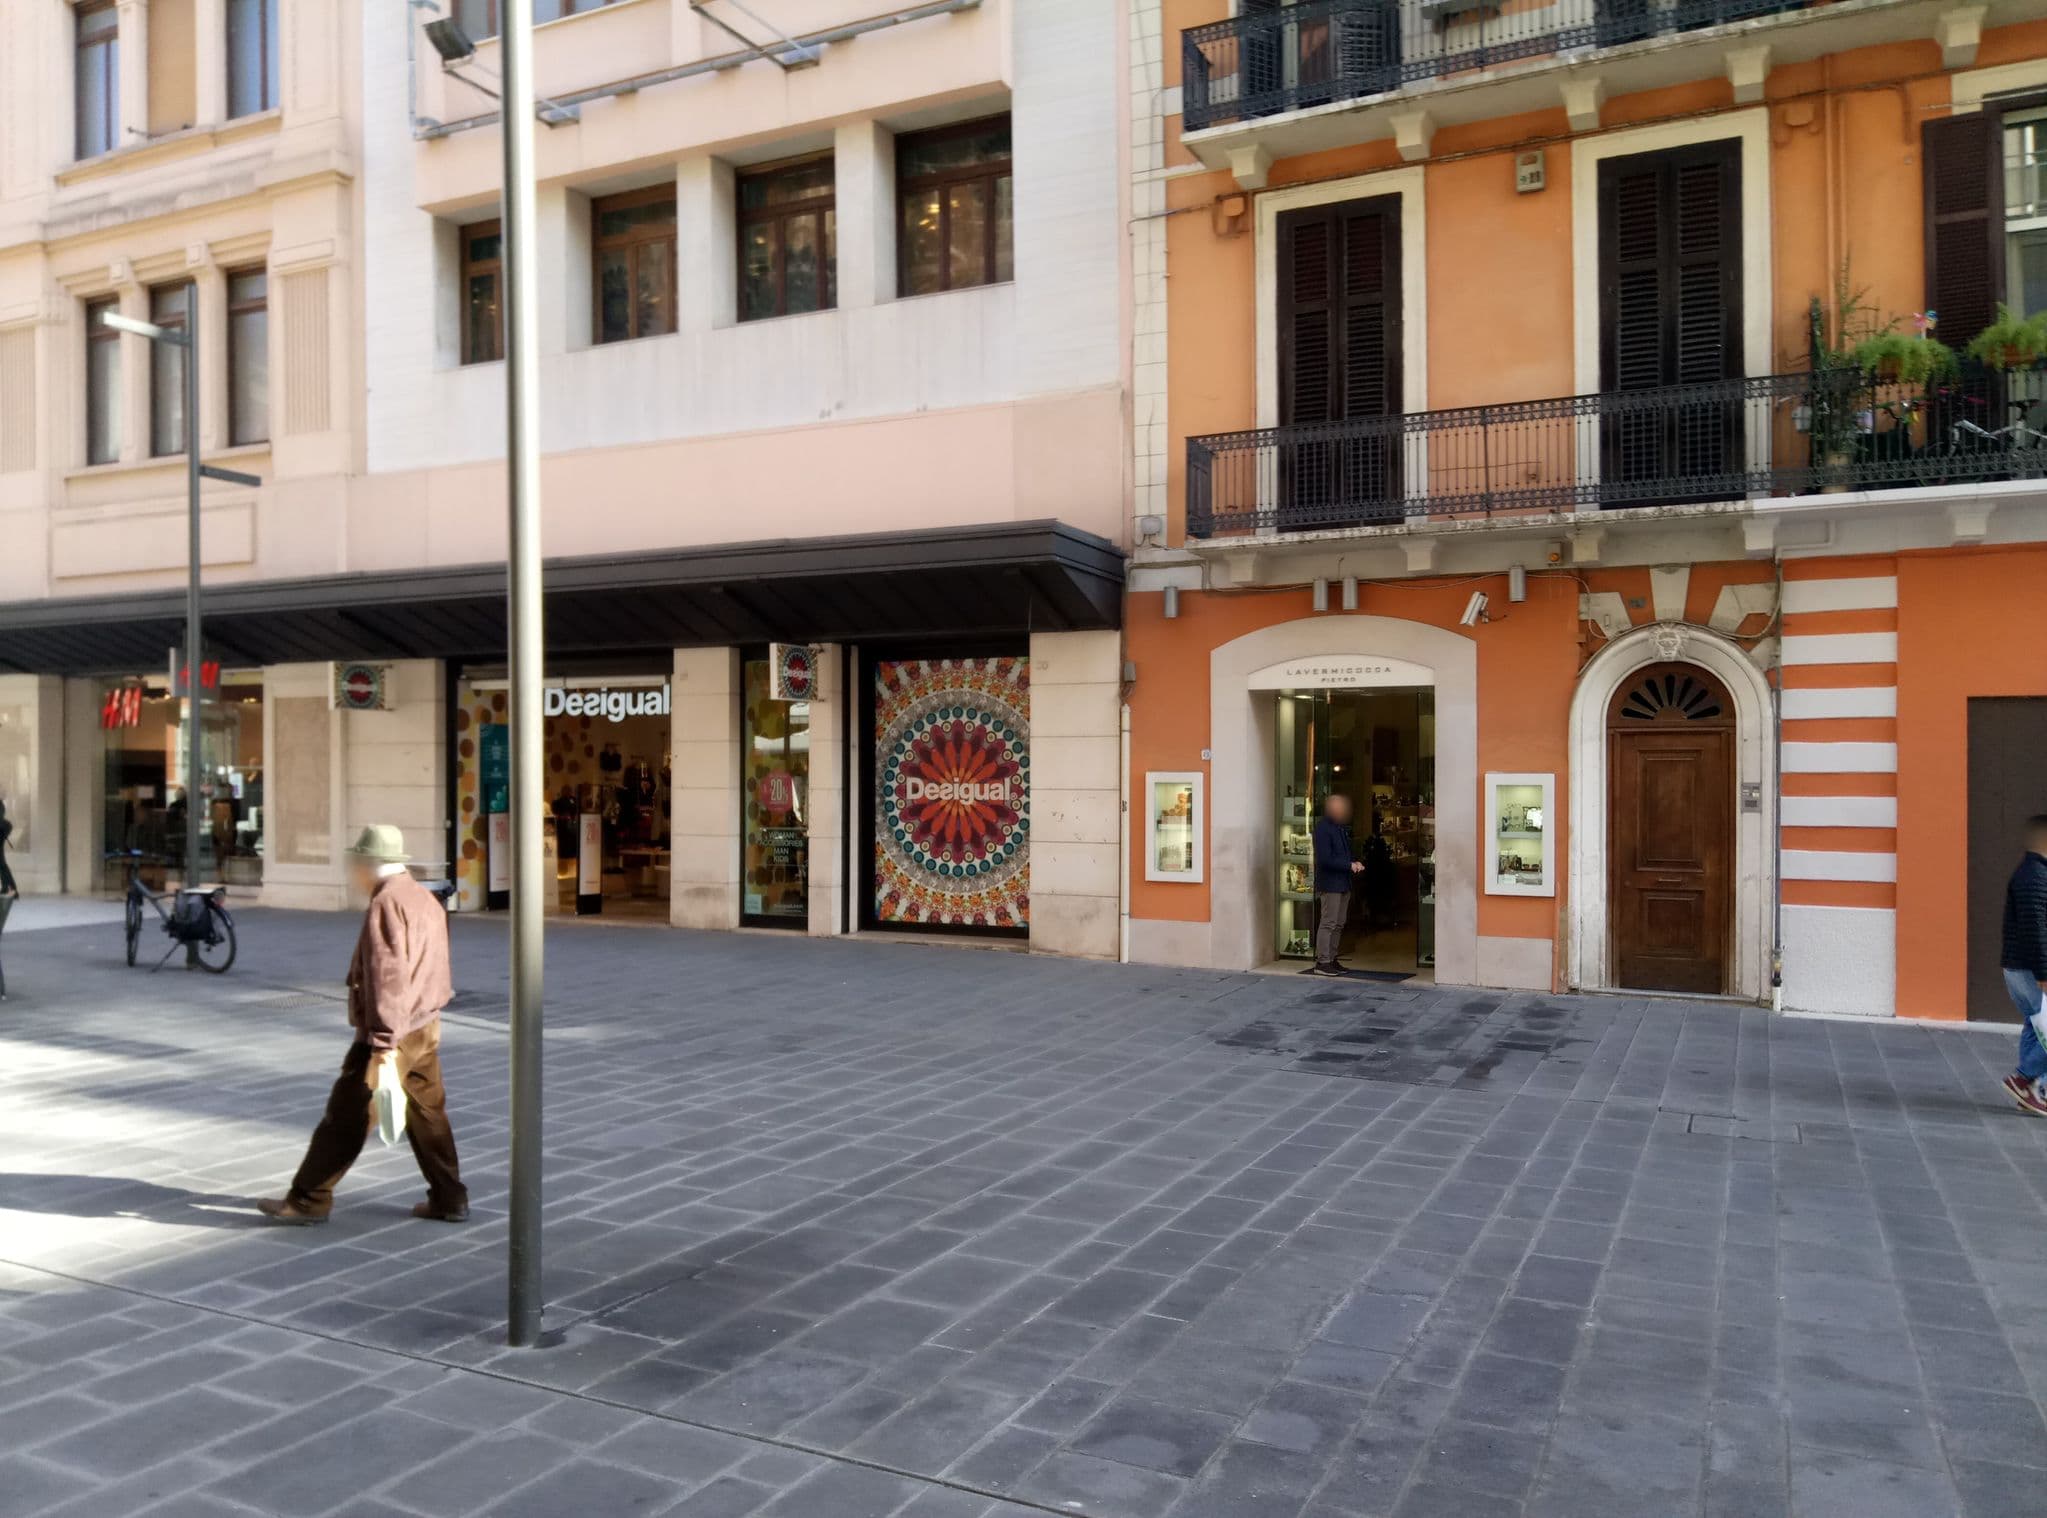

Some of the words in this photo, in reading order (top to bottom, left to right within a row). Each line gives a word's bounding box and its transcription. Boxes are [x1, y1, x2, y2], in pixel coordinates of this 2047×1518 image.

[178, 660, 219, 689] HM
[1286, 666, 1391, 676] LAVERMICOCCA
[543, 684, 670, 722] Desigual
[905, 776, 1010, 805] Desigual
[768, 831, 795, 840] WOMAN
[773, 847, 789, 855] MAN
